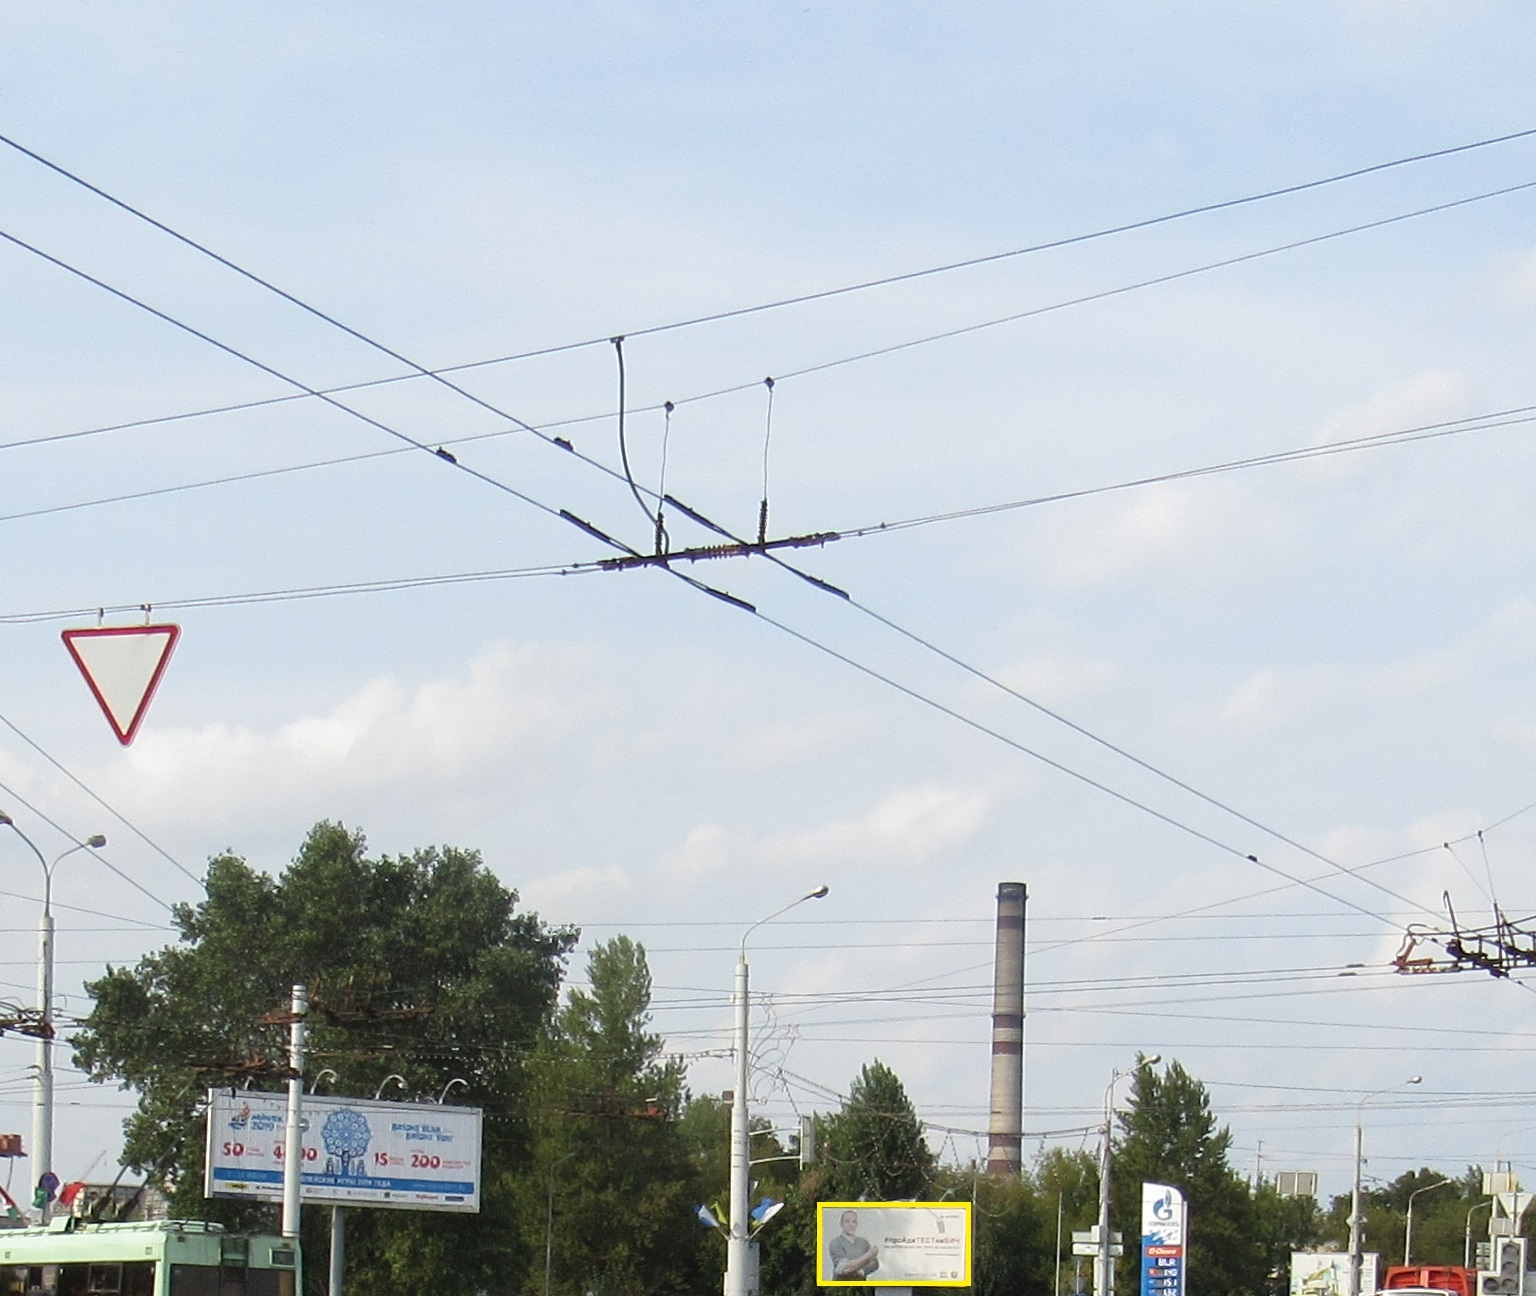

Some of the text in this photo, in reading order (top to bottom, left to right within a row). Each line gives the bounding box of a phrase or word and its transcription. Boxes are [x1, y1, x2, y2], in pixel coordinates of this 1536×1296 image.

[222, 1142, 244, 1157] 50
[374, 1152, 389, 1167] 15
[410, 1153, 441, 1169] 200
